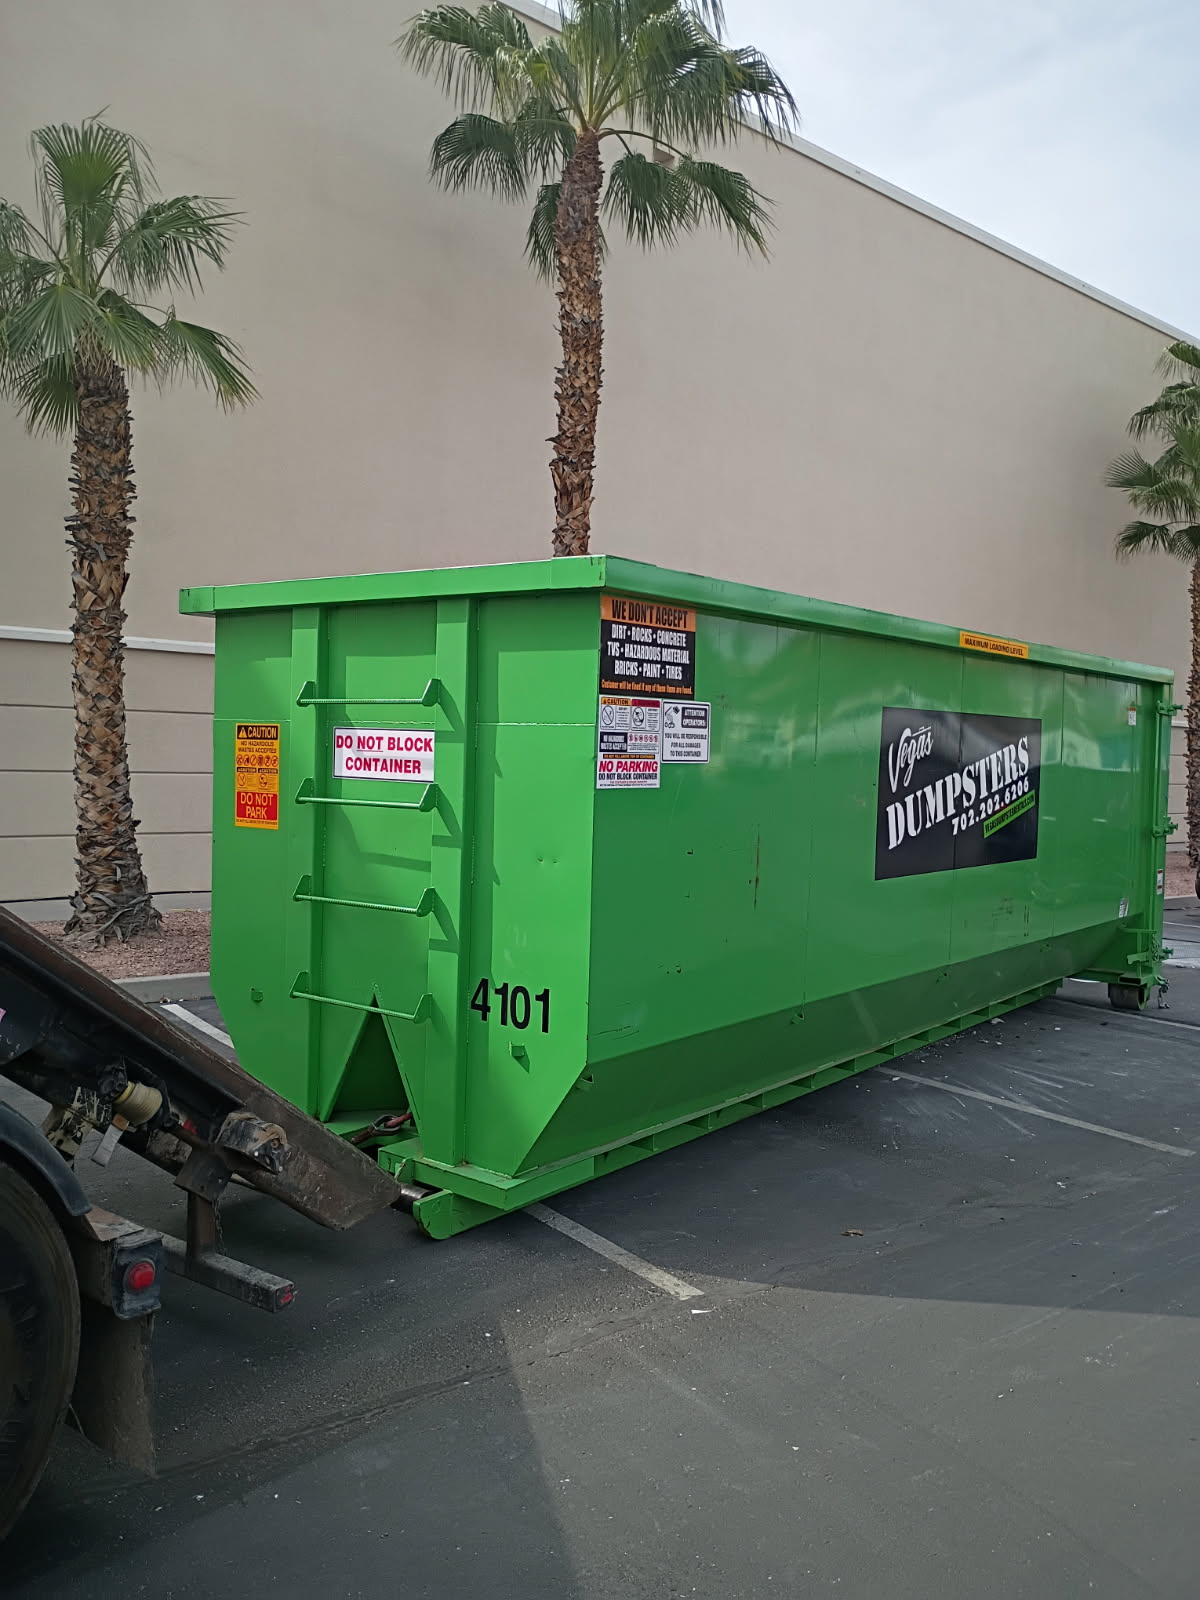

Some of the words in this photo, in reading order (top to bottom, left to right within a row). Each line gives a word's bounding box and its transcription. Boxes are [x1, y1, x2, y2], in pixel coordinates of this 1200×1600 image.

[612, 600, 626, 620] WE
[628, 601, 654, 624] DON'T
[656, 605, 688, 628] ACCEPT
[612, 624, 627, 639] DIRT
[631, 627, 652, 642] ROCKS
[656, 630, 686, 647] CONCRETE
[607, 641, 620, 656] TVS
[624, 643, 661, 661] HAZARDOUS
[661, 648, 690, 664] MATERIAL
[965, 637, 989, 649] MAXIMUM
[989, 643, 1009, 653] LOADING
[1010, 647, 1024, 656] LEVEL
[614, 660, 638, 676] BRICKS
[643, 663, 661, 678] PAINT
[665, 665, 682, 680] TIRES
[248, 727, 277, 739] CAUTION
[336, 735, 353, 749] DO
[357, 736, 384, 750] NOT
[387, 737, 433, 752] BLOCK
[345, 757, 421, 774] CONTAINER
[598, 760, 614, 772] NO
[616, 761, 658, 772] PARKING
[240, 792, 254, 804] DO
[255, 794, 273, 806] NOT
[886, 735, 1030, 850] DUMPSTERS
[246, 806, 267, 820] PARK
[951, 776, 1030, 836] 702.202.6206
[470, 978, 550, 1033] 4101
